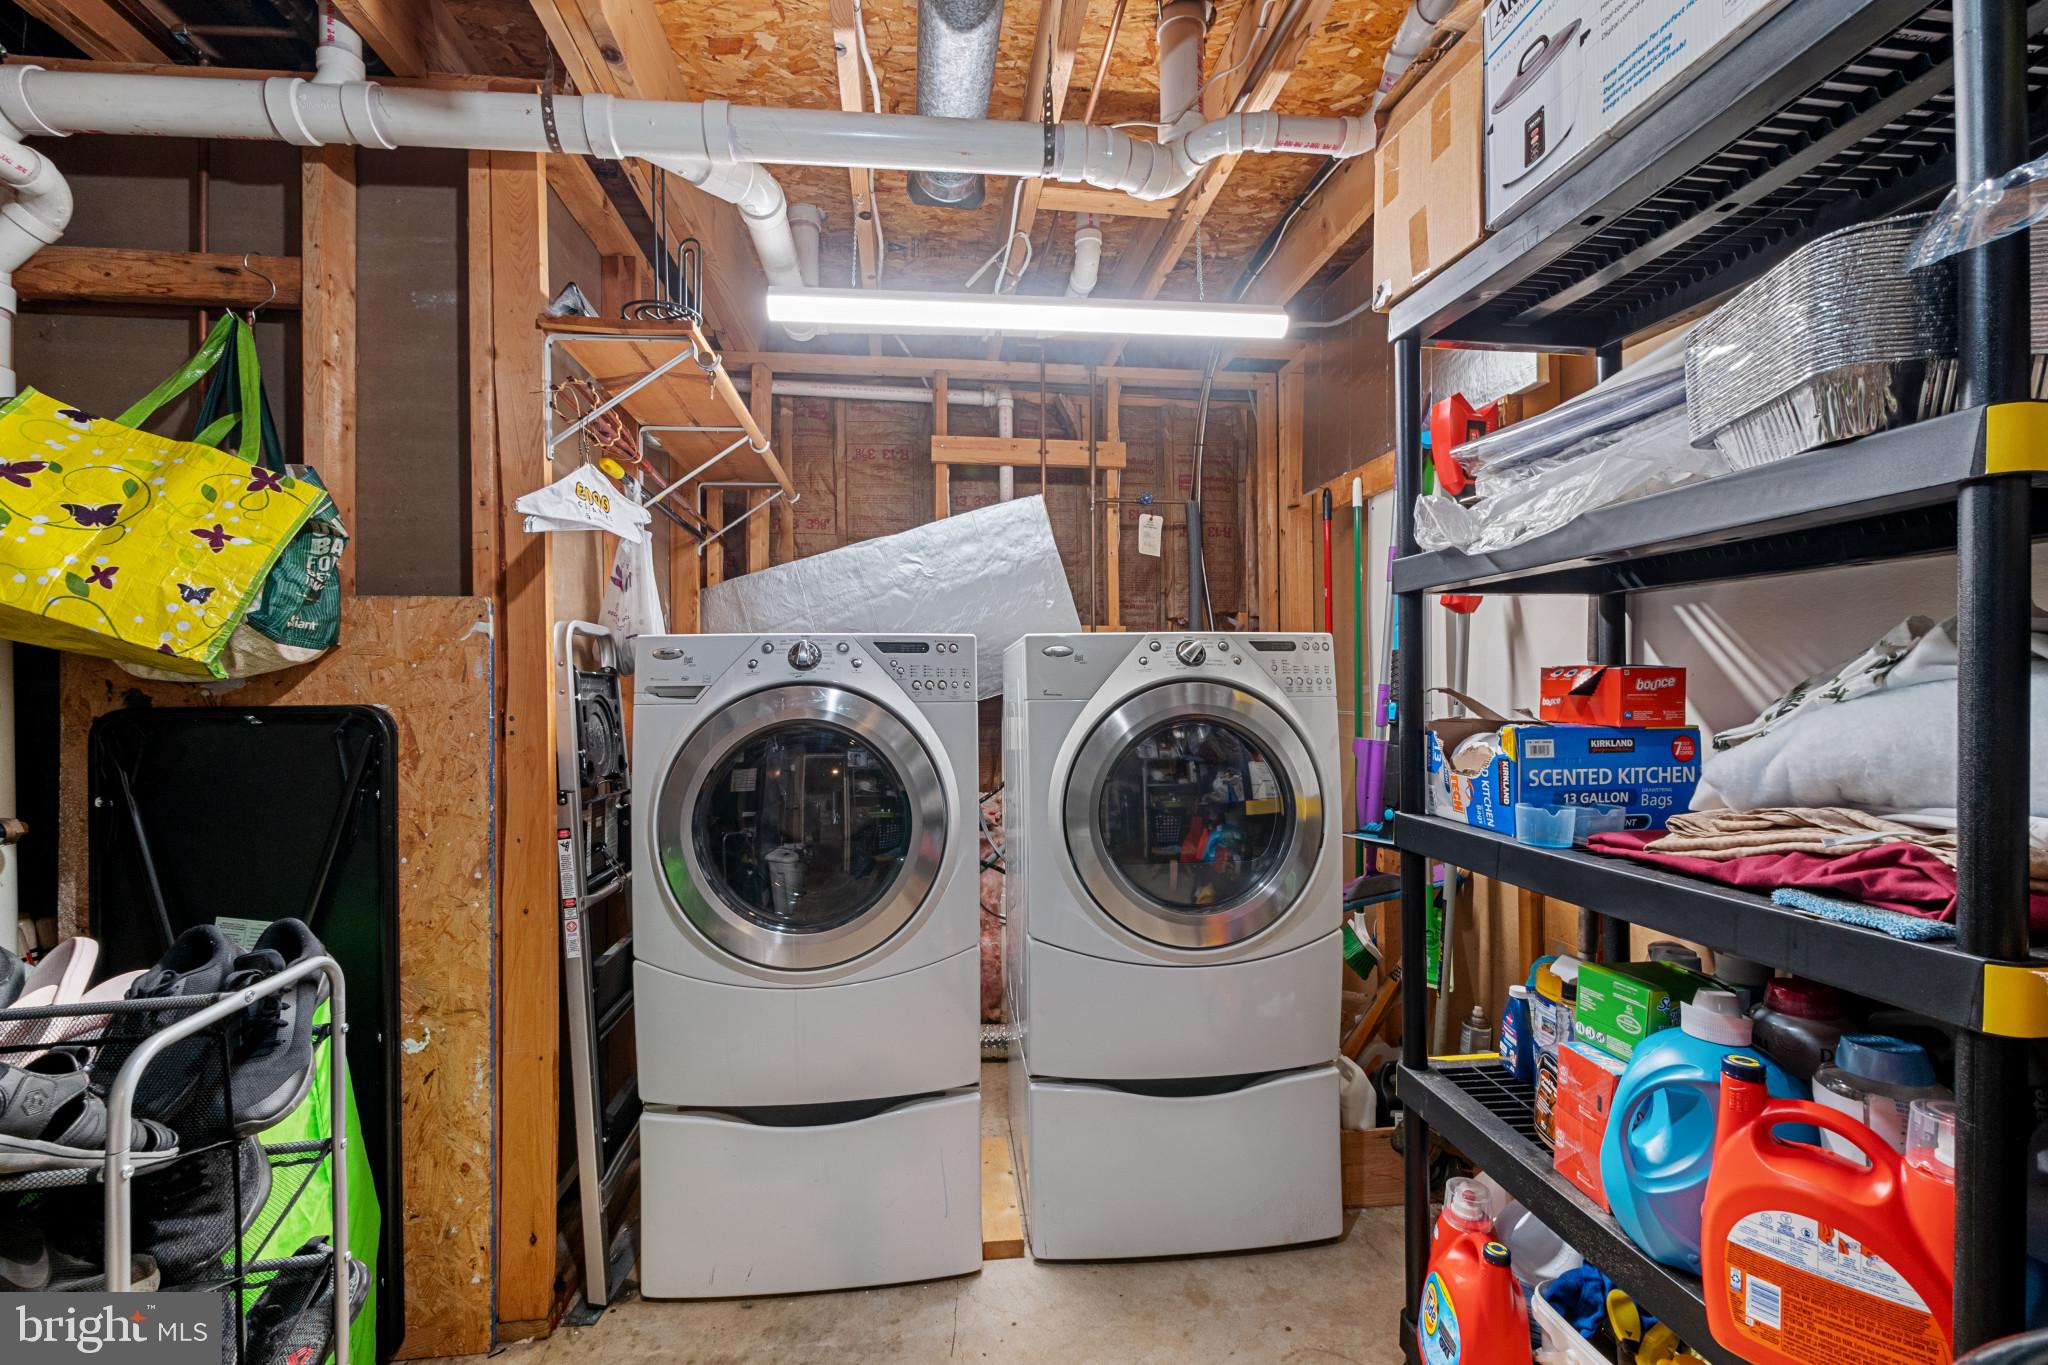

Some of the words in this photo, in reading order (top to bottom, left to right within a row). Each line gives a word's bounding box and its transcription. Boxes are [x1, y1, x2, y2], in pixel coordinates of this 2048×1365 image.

[1646, 32, 1673, 57] heating
[1636, 677, 1677, 691] bounce
[1542, 697, 1561, 706] bounce
[1590, 739, 1634, 748] KIRKLAND
[1673, 741, 1683, 756] 7
[1501, 760, 1511, 805] KIRKLAND
[1528, 767, 1613, 787] SCENTED
[1618, 766, 1696, 785] KITCHEN
[1481, 780, 1496, 828] KITCHEN
[1563, 792, 1577, 804] 13
[1580, 791, 1629, 804] GALLON
[1641, 794, 1673, 809] Bags
[1424, 1290, 1437, 1323] Tide
